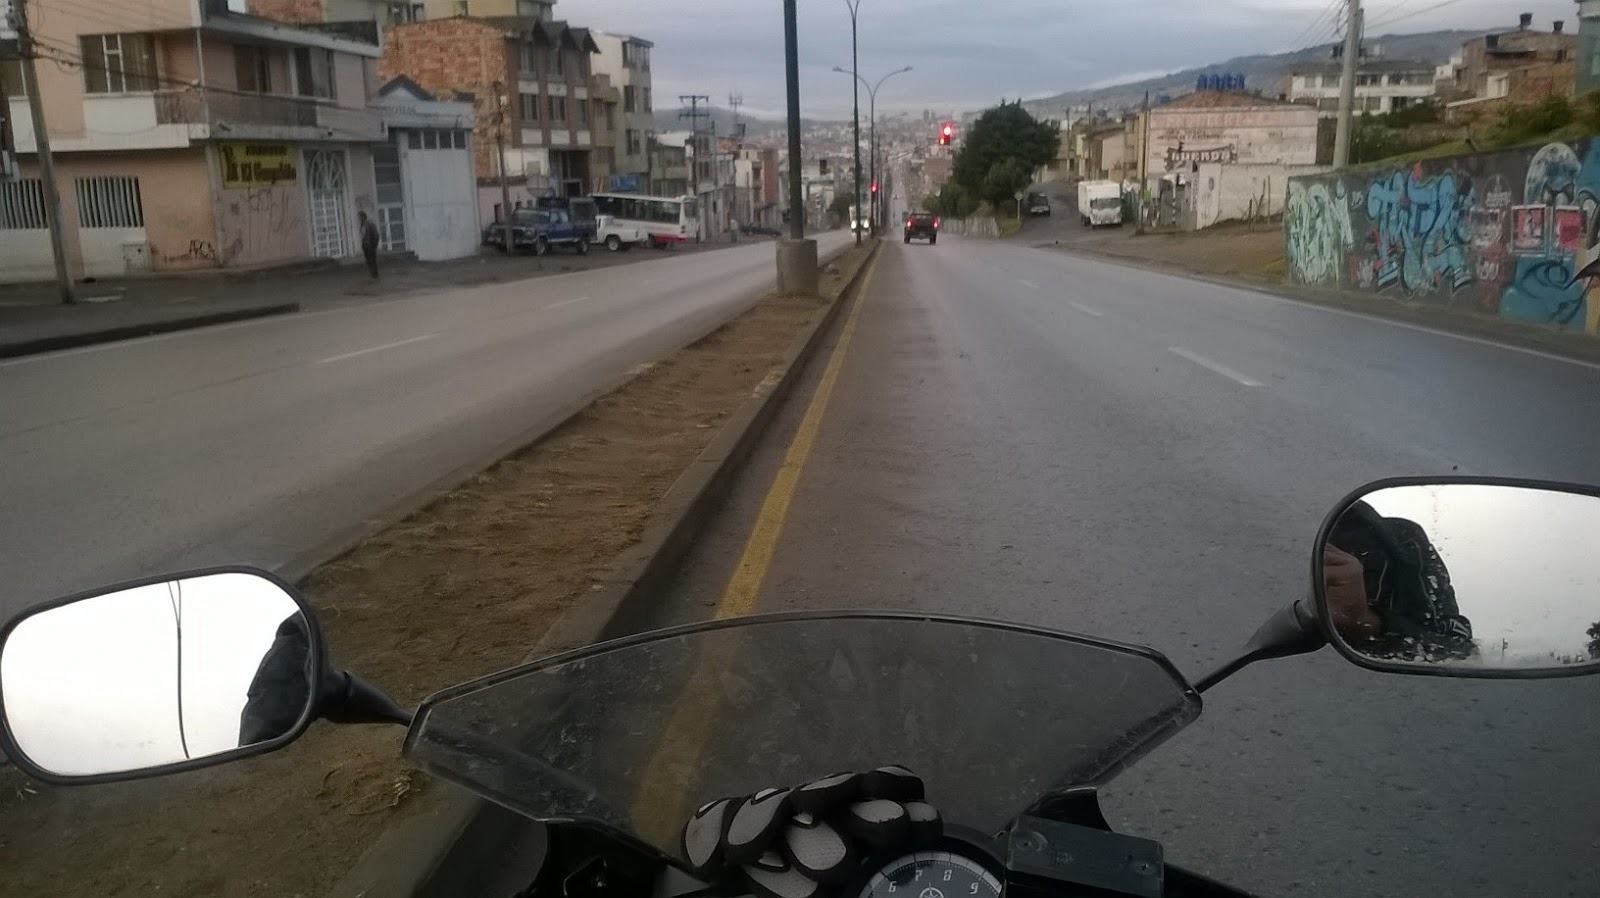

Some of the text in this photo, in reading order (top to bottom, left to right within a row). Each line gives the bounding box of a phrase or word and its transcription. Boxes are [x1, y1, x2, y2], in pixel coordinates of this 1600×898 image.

[915, 869, 923, 881] 7
[943, 869, 952, 881] 8
[888, 880, 897, 893] 6
[969, 882, 979, 895] 9
